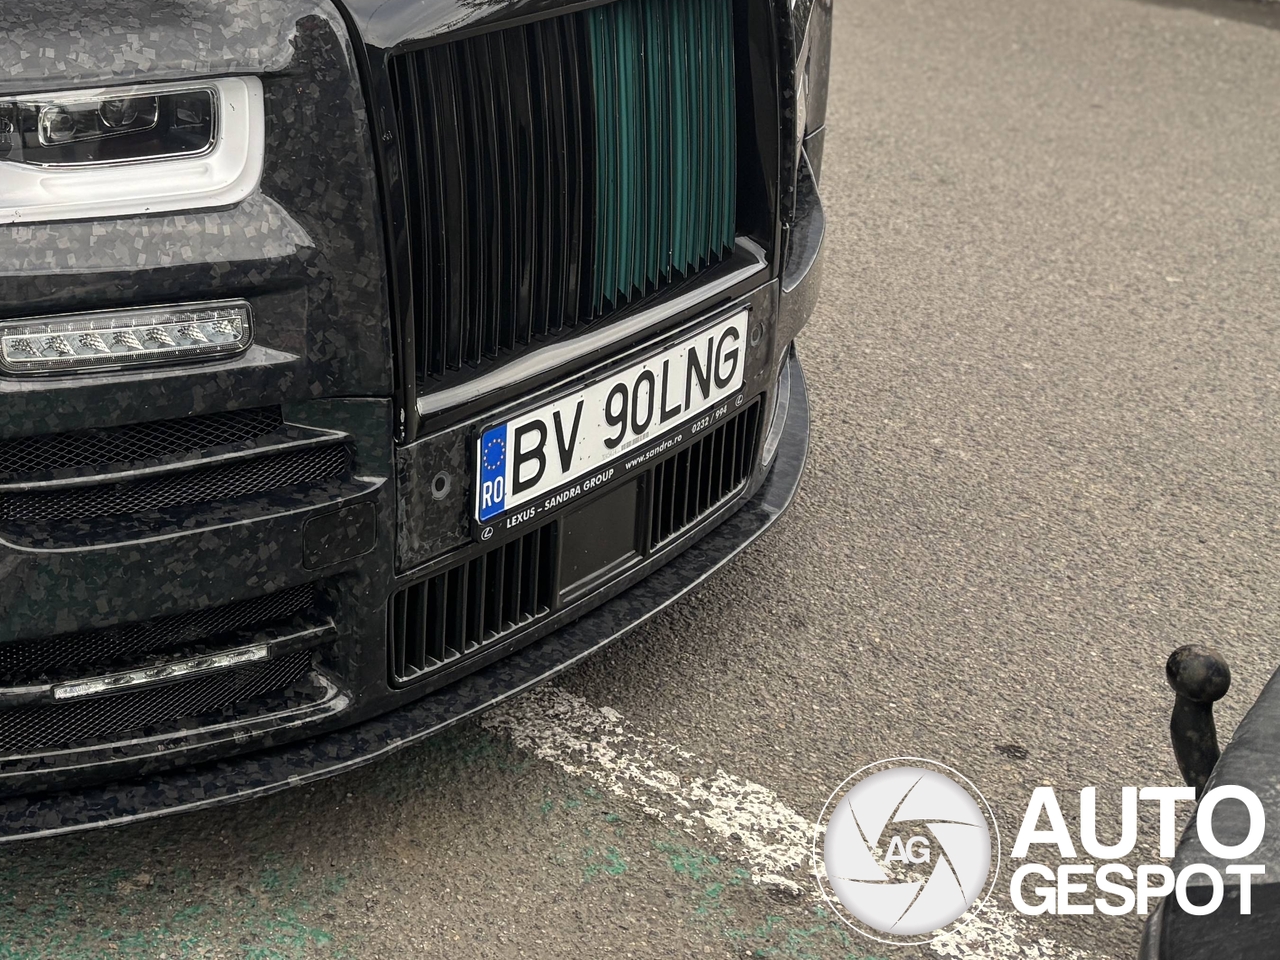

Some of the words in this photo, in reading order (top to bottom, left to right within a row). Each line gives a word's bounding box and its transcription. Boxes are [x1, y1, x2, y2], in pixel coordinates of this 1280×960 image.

[482, 476, 503, 510] RO
[506, 506, 536, 529] LEXUS
[544, 485, 581, 511] SANDRA
[583, 468, 614, 491] GROUP
[625, 434, 683, 470] www.sandra.ro
[512, 401, 583, 496] BV
